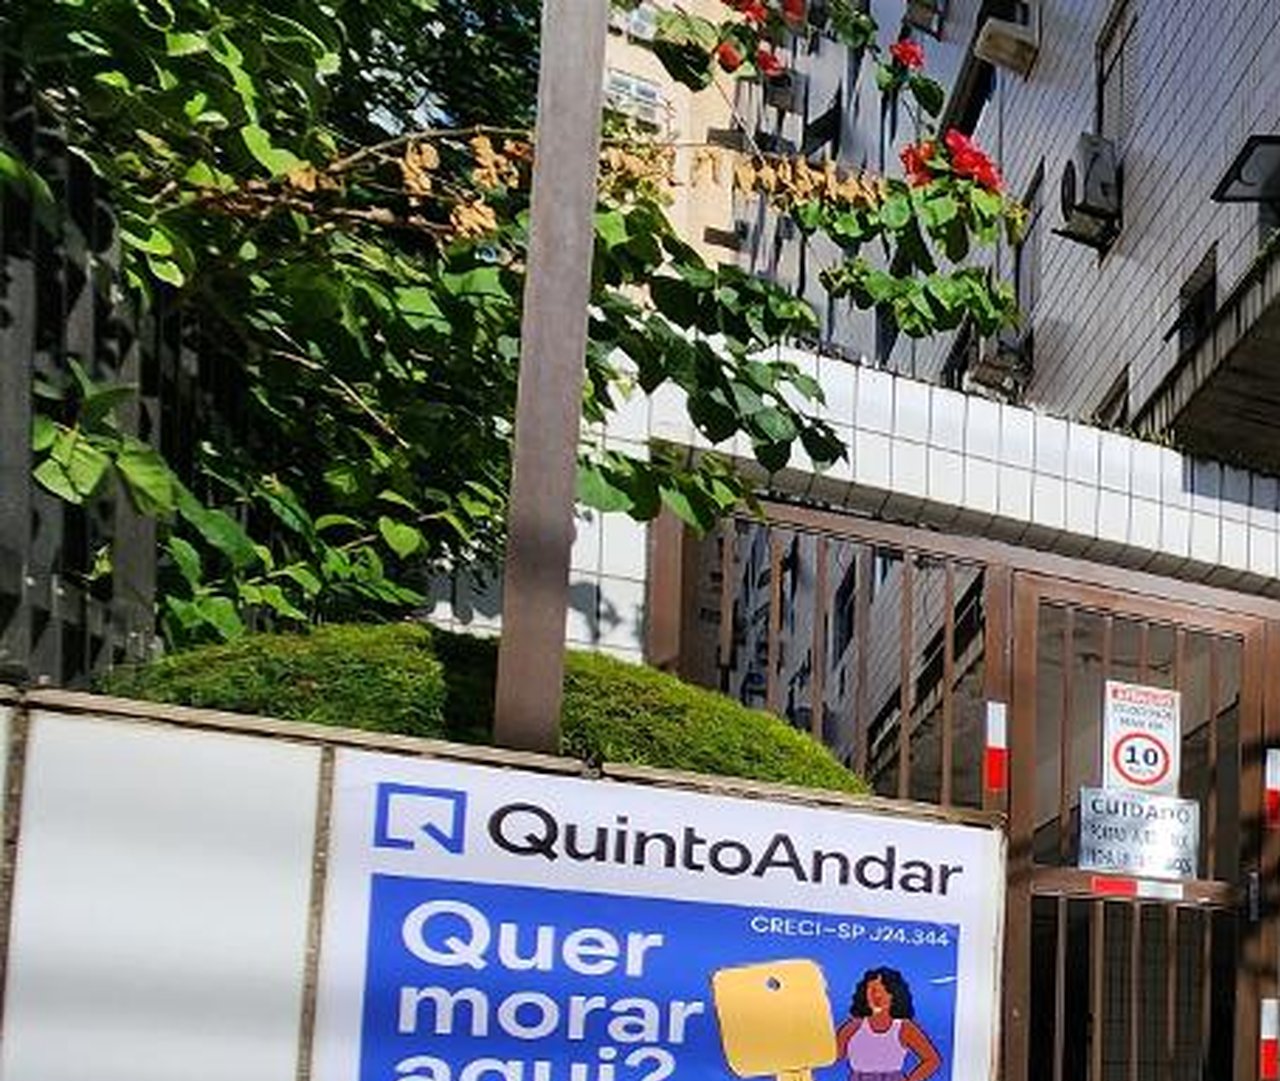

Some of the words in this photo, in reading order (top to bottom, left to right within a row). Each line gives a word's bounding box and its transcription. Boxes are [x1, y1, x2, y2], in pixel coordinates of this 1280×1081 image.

[1124, 745, 1159, 767] 10
[488, 801, 966, 896] QuintoAndar
[400, 899, 665, 977] Quer
[398, 983, 705, 1045] morar
